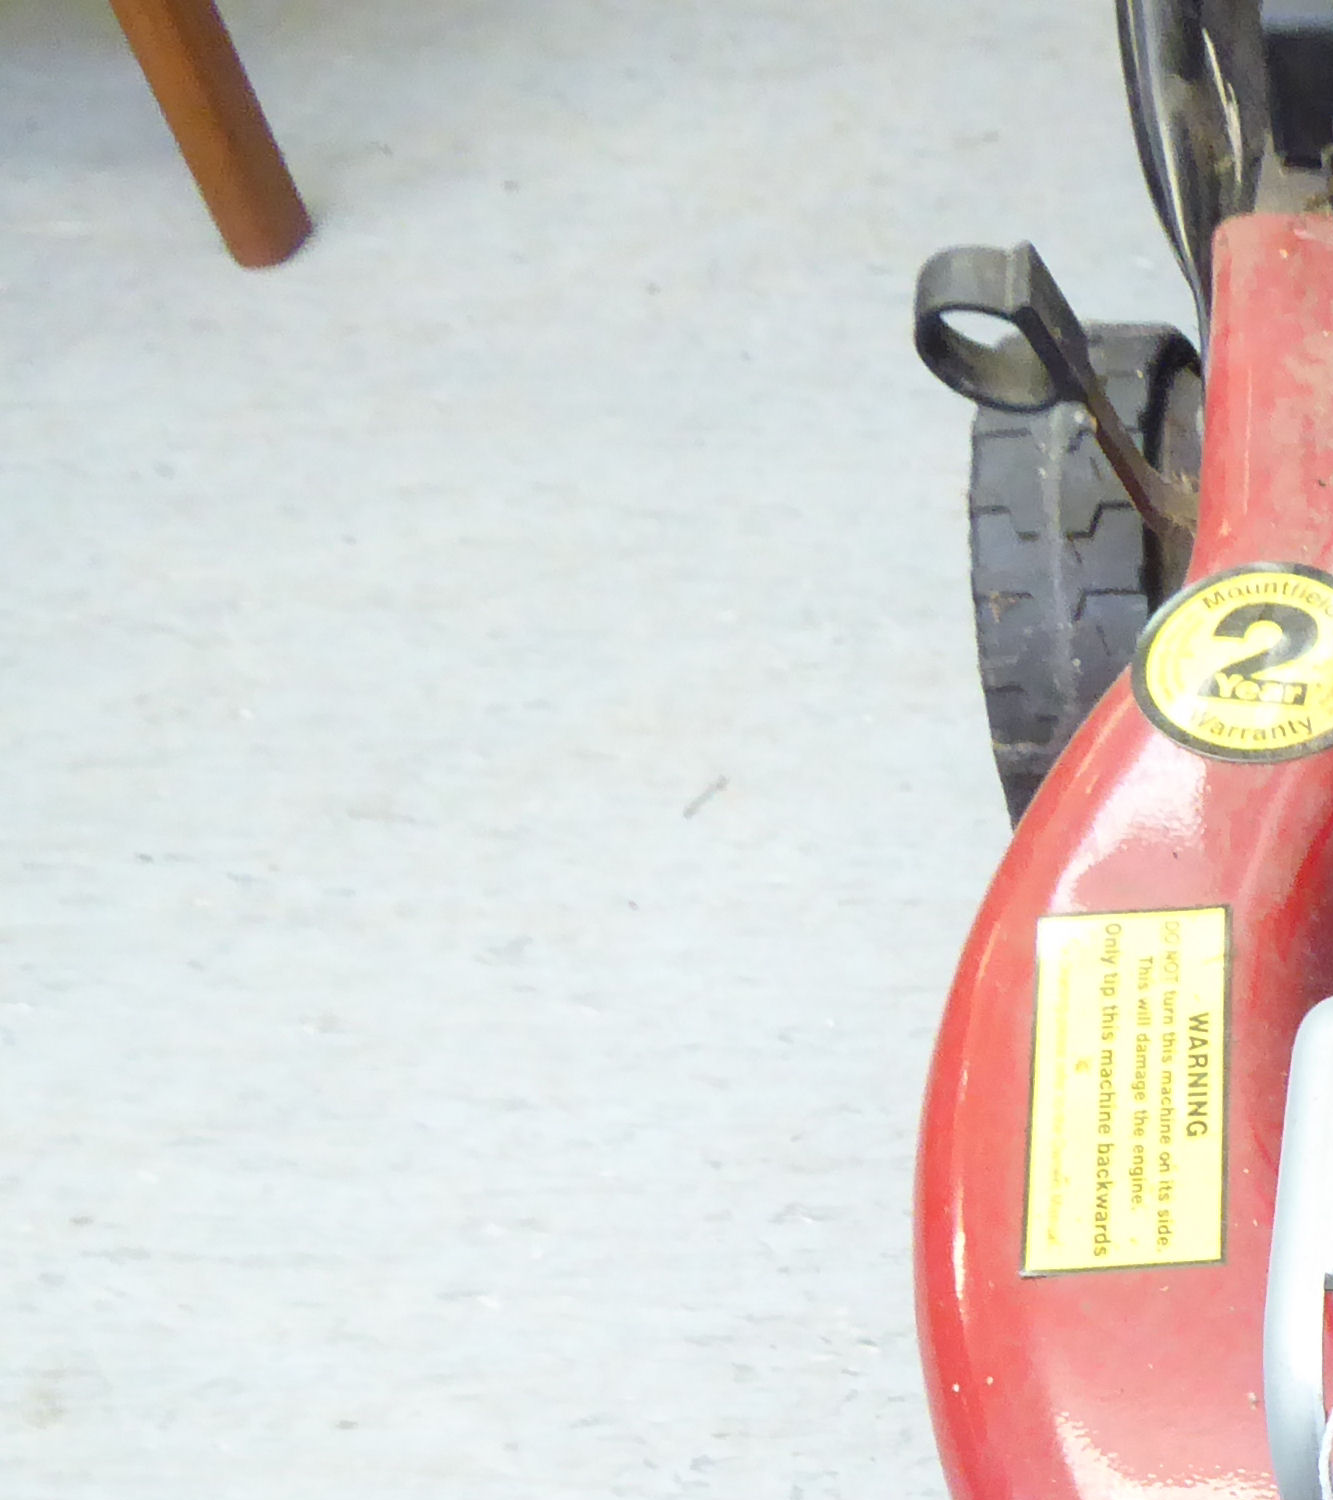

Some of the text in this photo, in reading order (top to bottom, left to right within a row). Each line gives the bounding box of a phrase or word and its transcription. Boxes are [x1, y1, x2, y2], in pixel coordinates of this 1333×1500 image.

[1198, 602, 1318, 701] 2
[1214, 672, 1307, 705] Year
[1192, 710, 1313, 742] Warranty
[1137, 956, 1154, 990] This
[1162, 950, 1179, 984] NOT
[1137, 997, 1152, 1026] will
[1162, 990, 1177, 1024] turn
[1161, 1032, 1177, 1063] this
[1131, 1033, 1151, 1101] damage
[1186, 1012, 1210, 1138] WARNING
[1093, 923, 1122, 1257] Only tip this machine backwards
[1159, 1070, 1175, 1144] machine
[1133, 1110, 1149, 1137] the
[1158, 1151, 1172, 1173] on
[1158, 1180, 1174, 1201] its
